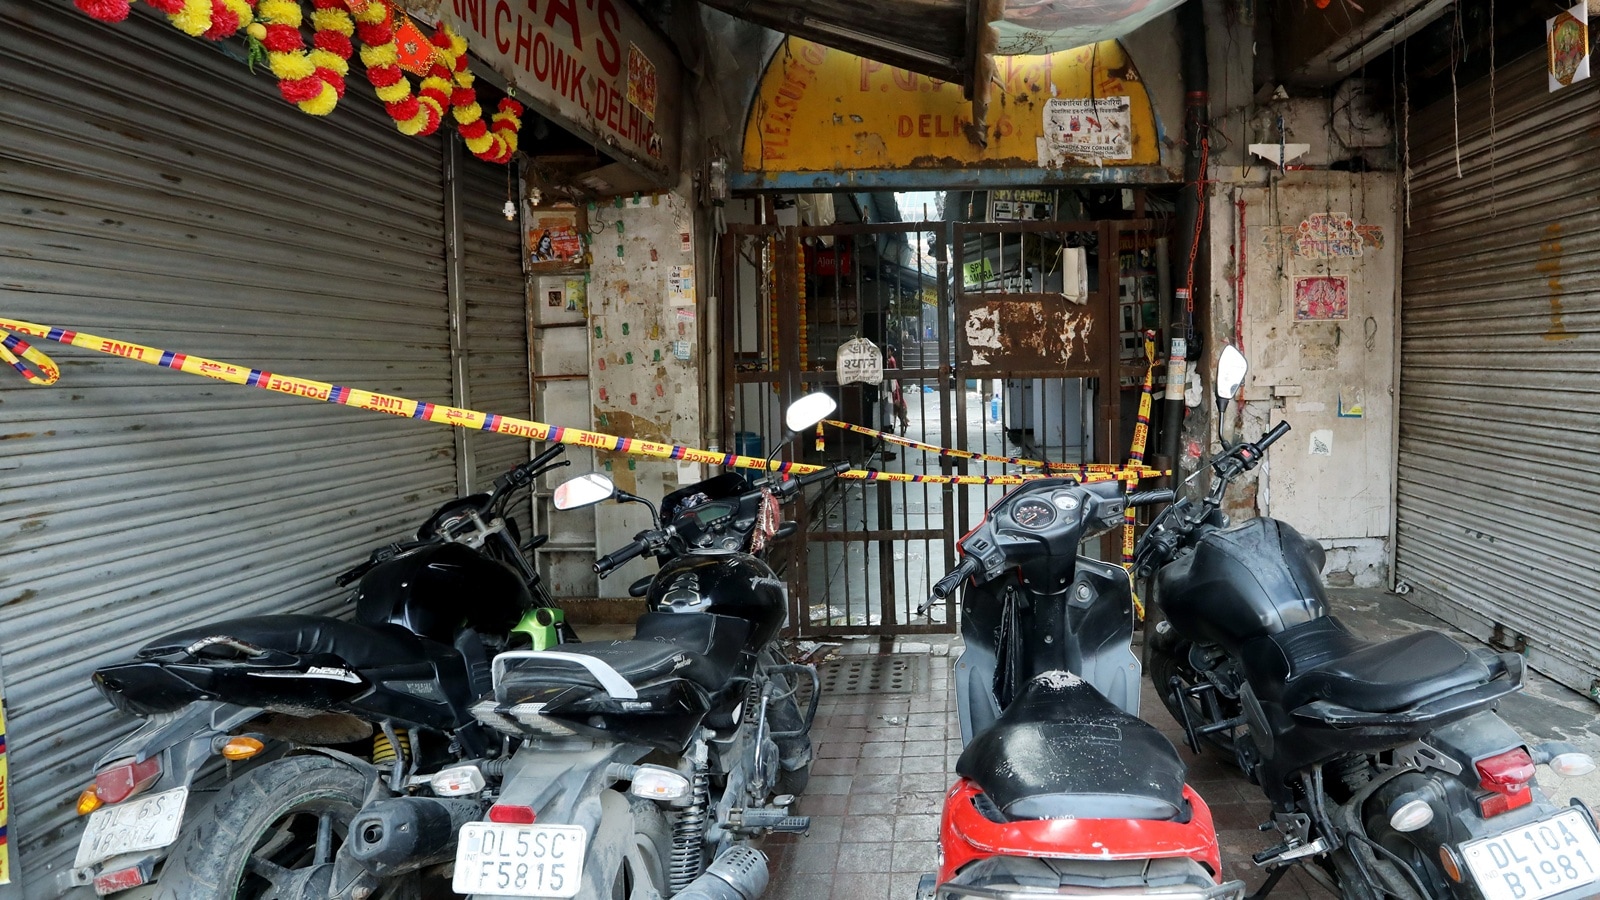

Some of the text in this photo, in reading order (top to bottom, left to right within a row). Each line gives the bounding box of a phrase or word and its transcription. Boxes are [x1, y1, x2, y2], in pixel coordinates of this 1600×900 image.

[494, 3, 592, 118] CHOWK,
[994, 190, 1053, 203] SPY CAMERA
[100, 340, 145, 360] LINE
[270, 379, 328, 399] POLICE
[370, 395, 403, 410] LINE
[501, 423, 547, 439] POLICE
[579, 433, 607, 446] LINE
[1133, 424, 1143, 446] CROSS
[684, 453, 723, 466] POLICE
[748, 459, 768, 469] INE
[888, 474, 906, 482] LINE
[481, 829, 566, 859] DL5SC
[1486, 820, 1579, 870] DL10A
[479, 861, 565, 891] F5815
[1502, 848, 1594, 899] B1981
